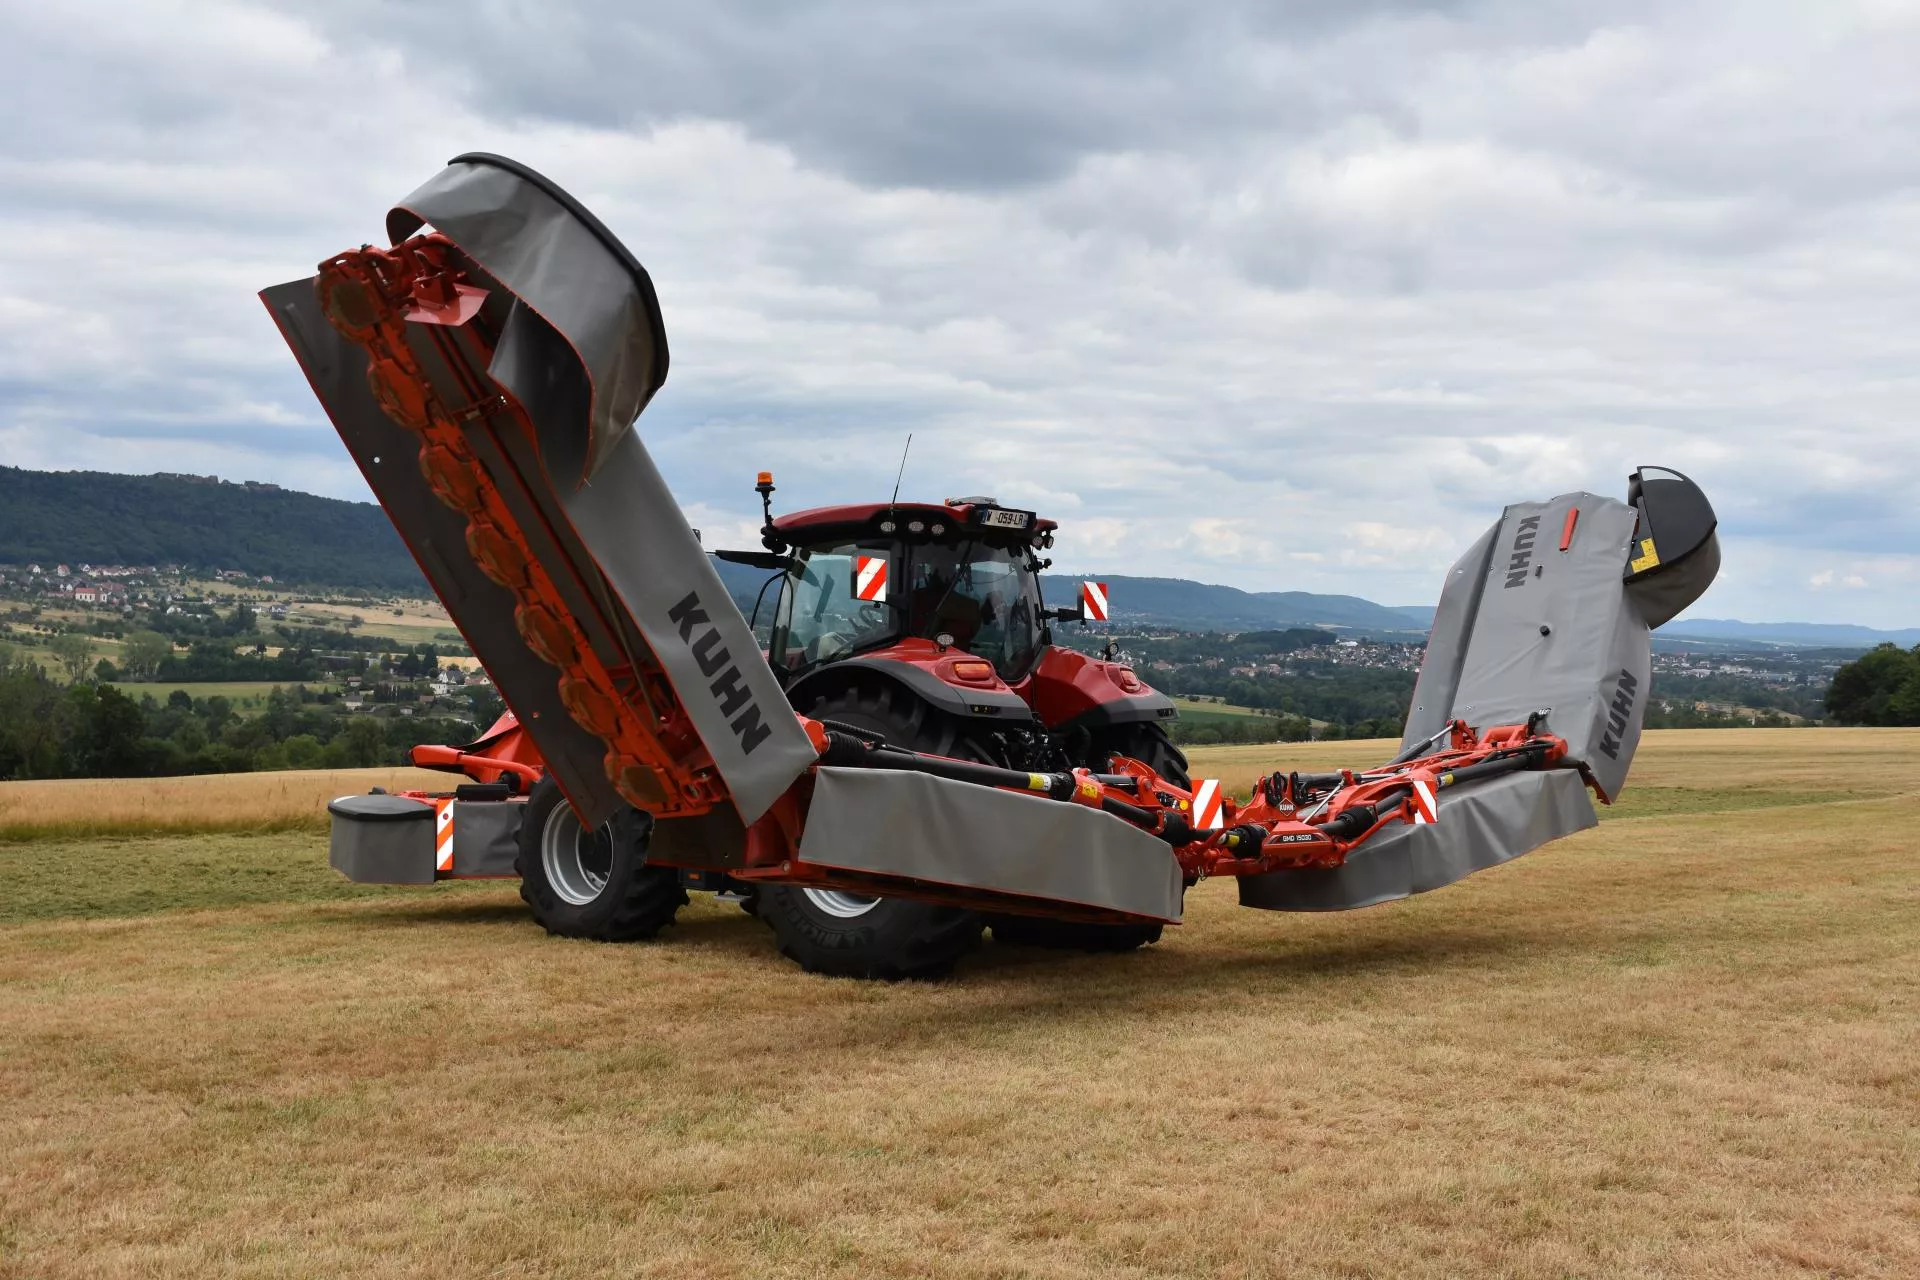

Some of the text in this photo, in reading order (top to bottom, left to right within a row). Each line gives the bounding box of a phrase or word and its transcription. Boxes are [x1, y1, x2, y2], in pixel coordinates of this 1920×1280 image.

[1504, 515, 1541, 589] KUHN
[667, 590, 772, 756] KUHN
[1599, 668, 1638, 761] KUHN
